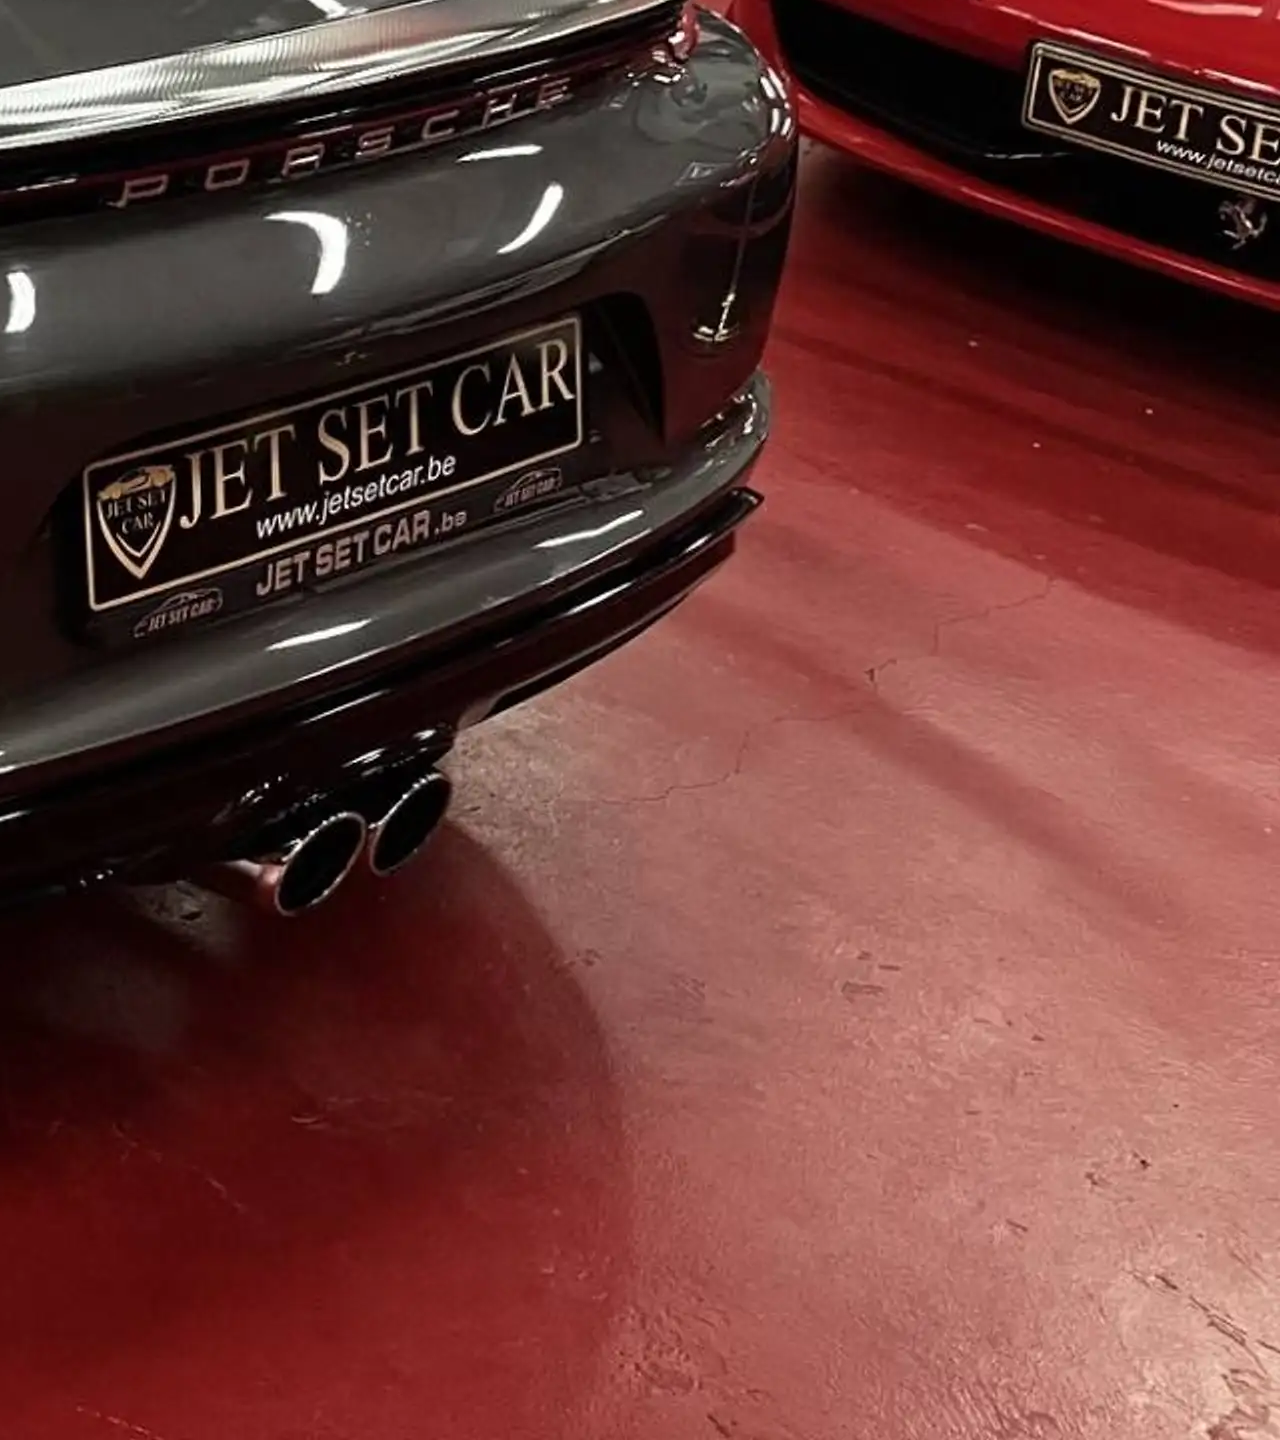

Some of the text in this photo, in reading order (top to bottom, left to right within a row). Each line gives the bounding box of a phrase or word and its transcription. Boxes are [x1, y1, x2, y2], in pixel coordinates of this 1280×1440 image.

[107, 77, 572, 208] PORSCHE
[1110, 83, 1280, 167] JET SE
[1156, 140, 1280, 186] www.jetsetc
[180, 338, 576, 529] JET SET CAR
[121, 512, 155, 535] CAR
[256, 454, 457, 539] www.jetsetcar.be
[256, 549, 310, 597] JET
[315, 530, 371, 576] SET
